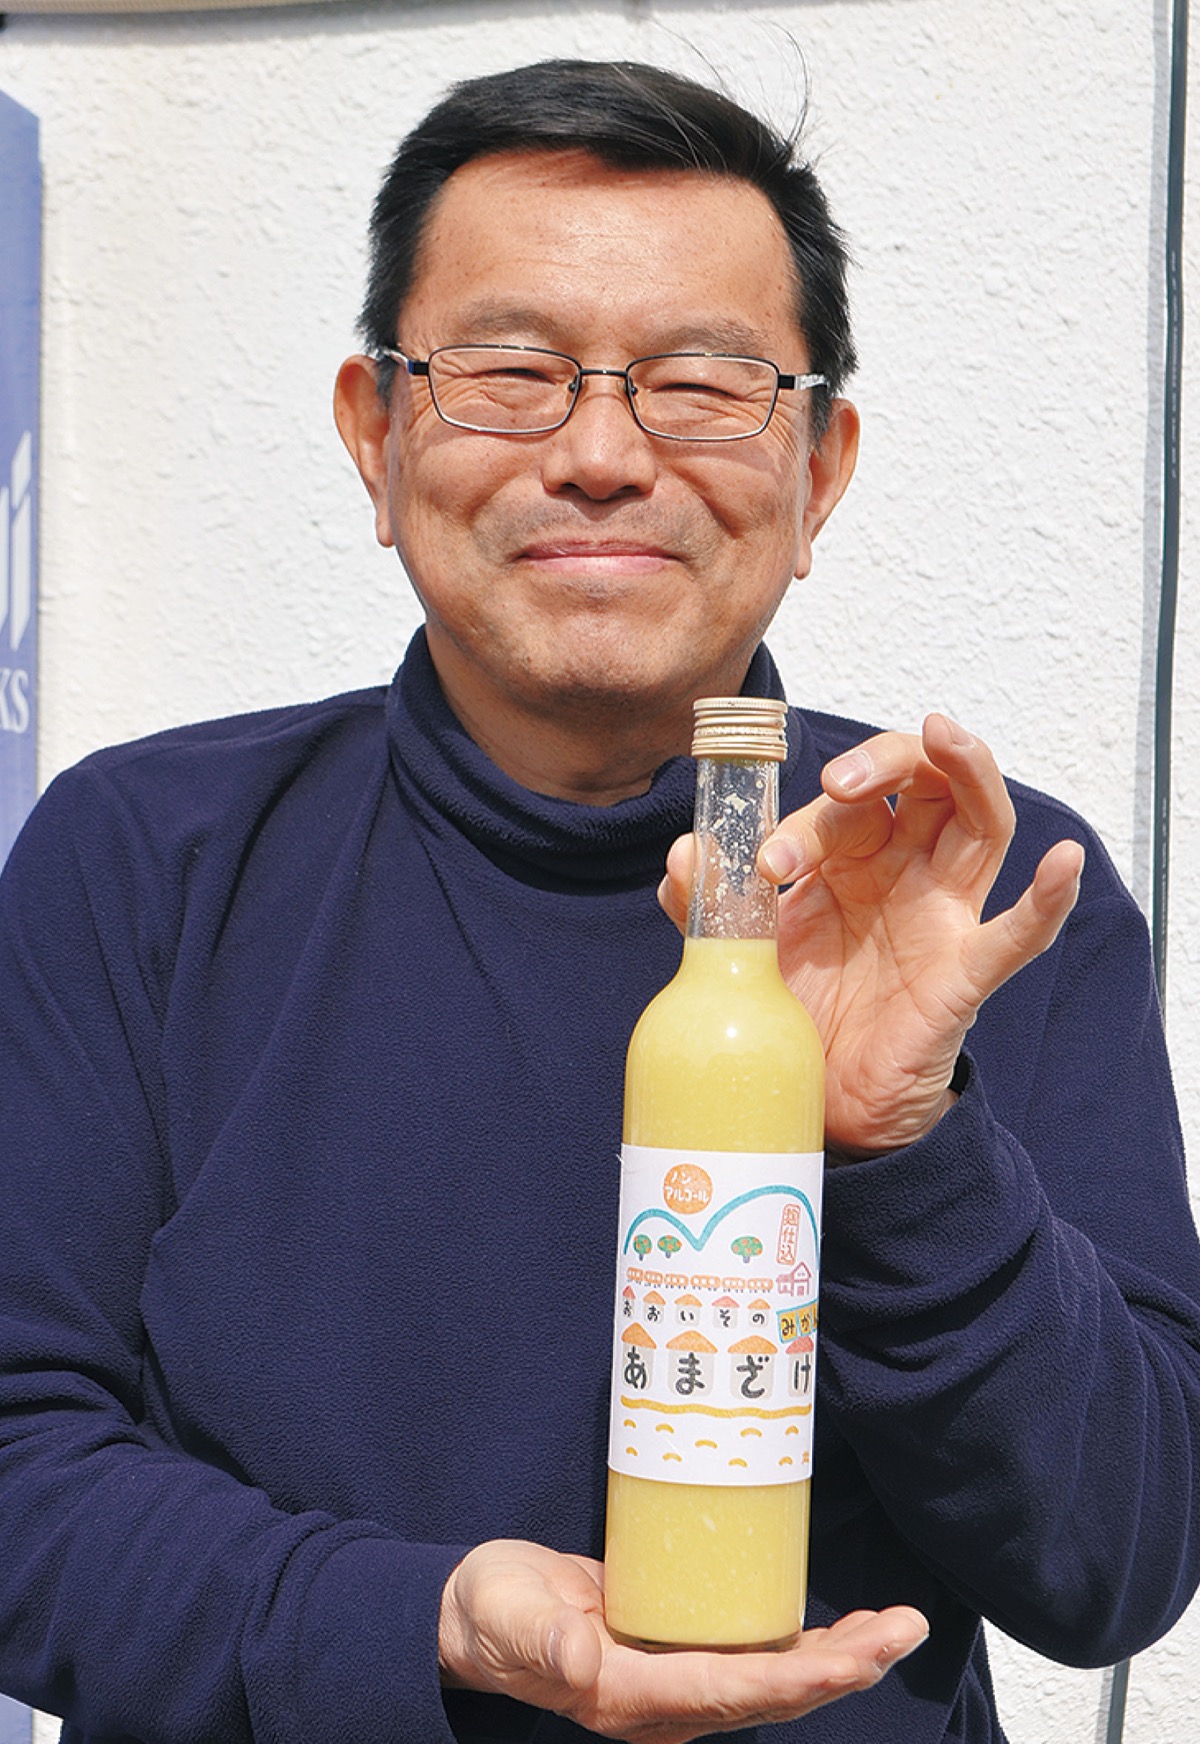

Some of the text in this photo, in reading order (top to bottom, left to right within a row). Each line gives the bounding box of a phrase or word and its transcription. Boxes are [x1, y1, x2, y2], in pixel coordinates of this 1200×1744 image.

[671, 1171, 691, 1185] ノン
[665, 1186, 709, 1203] アルコール
[623, 1300, 766, 1328] おおいその
[781, 1308, 817, 1336] みか
[624, 1346, 811, 1399] あまざけ
